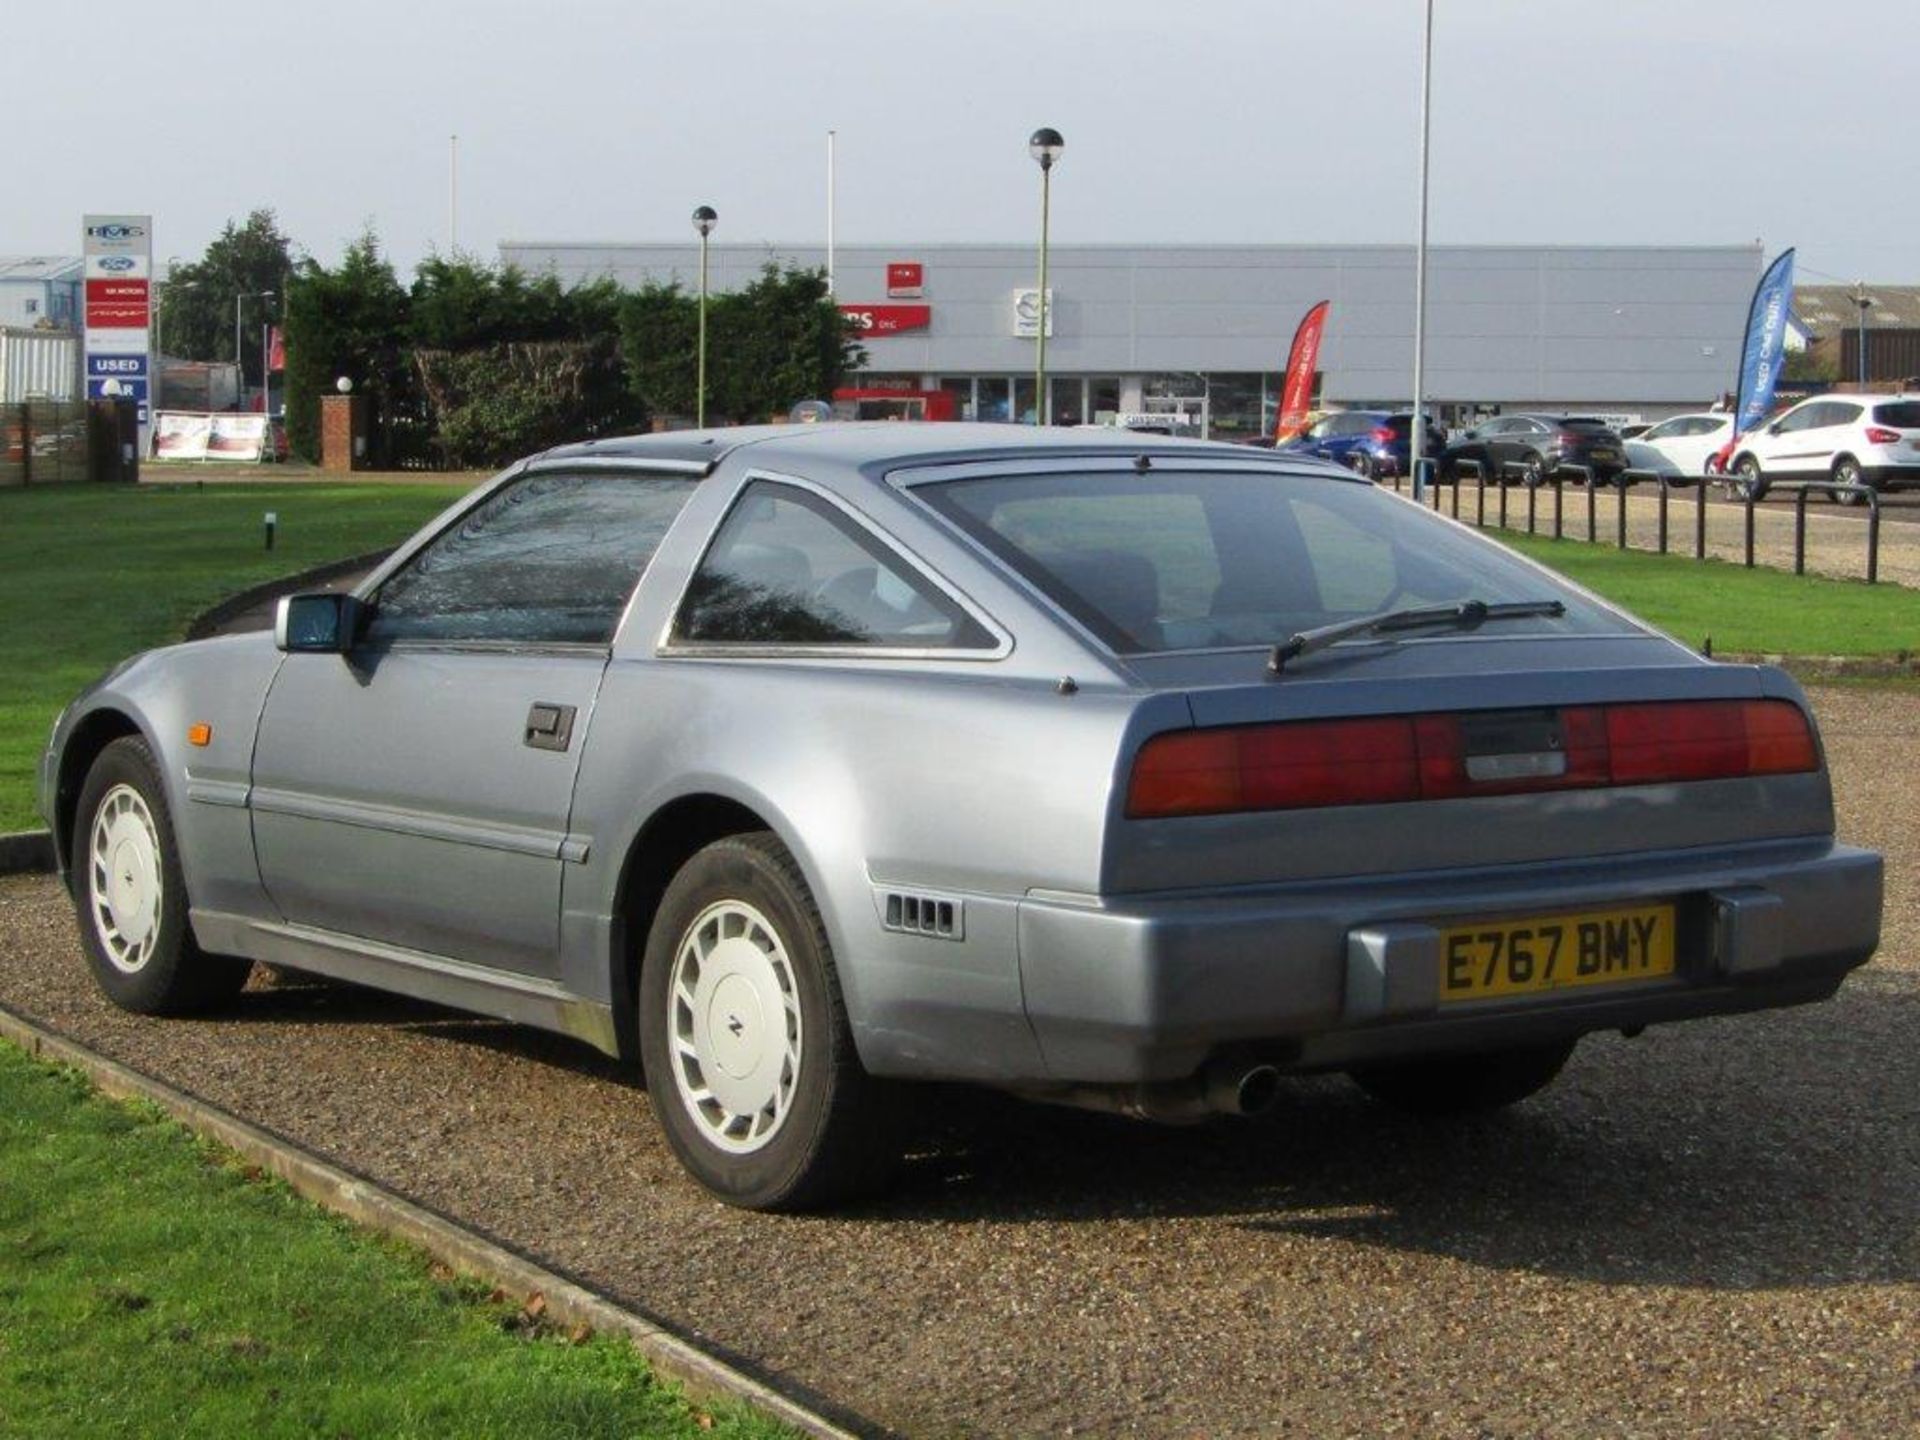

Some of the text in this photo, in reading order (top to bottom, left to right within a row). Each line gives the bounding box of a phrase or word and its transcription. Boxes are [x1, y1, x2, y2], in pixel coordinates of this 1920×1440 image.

[96, 359, 139, 372] USED
[1447, 916, 1657, 990] E767 BMY
